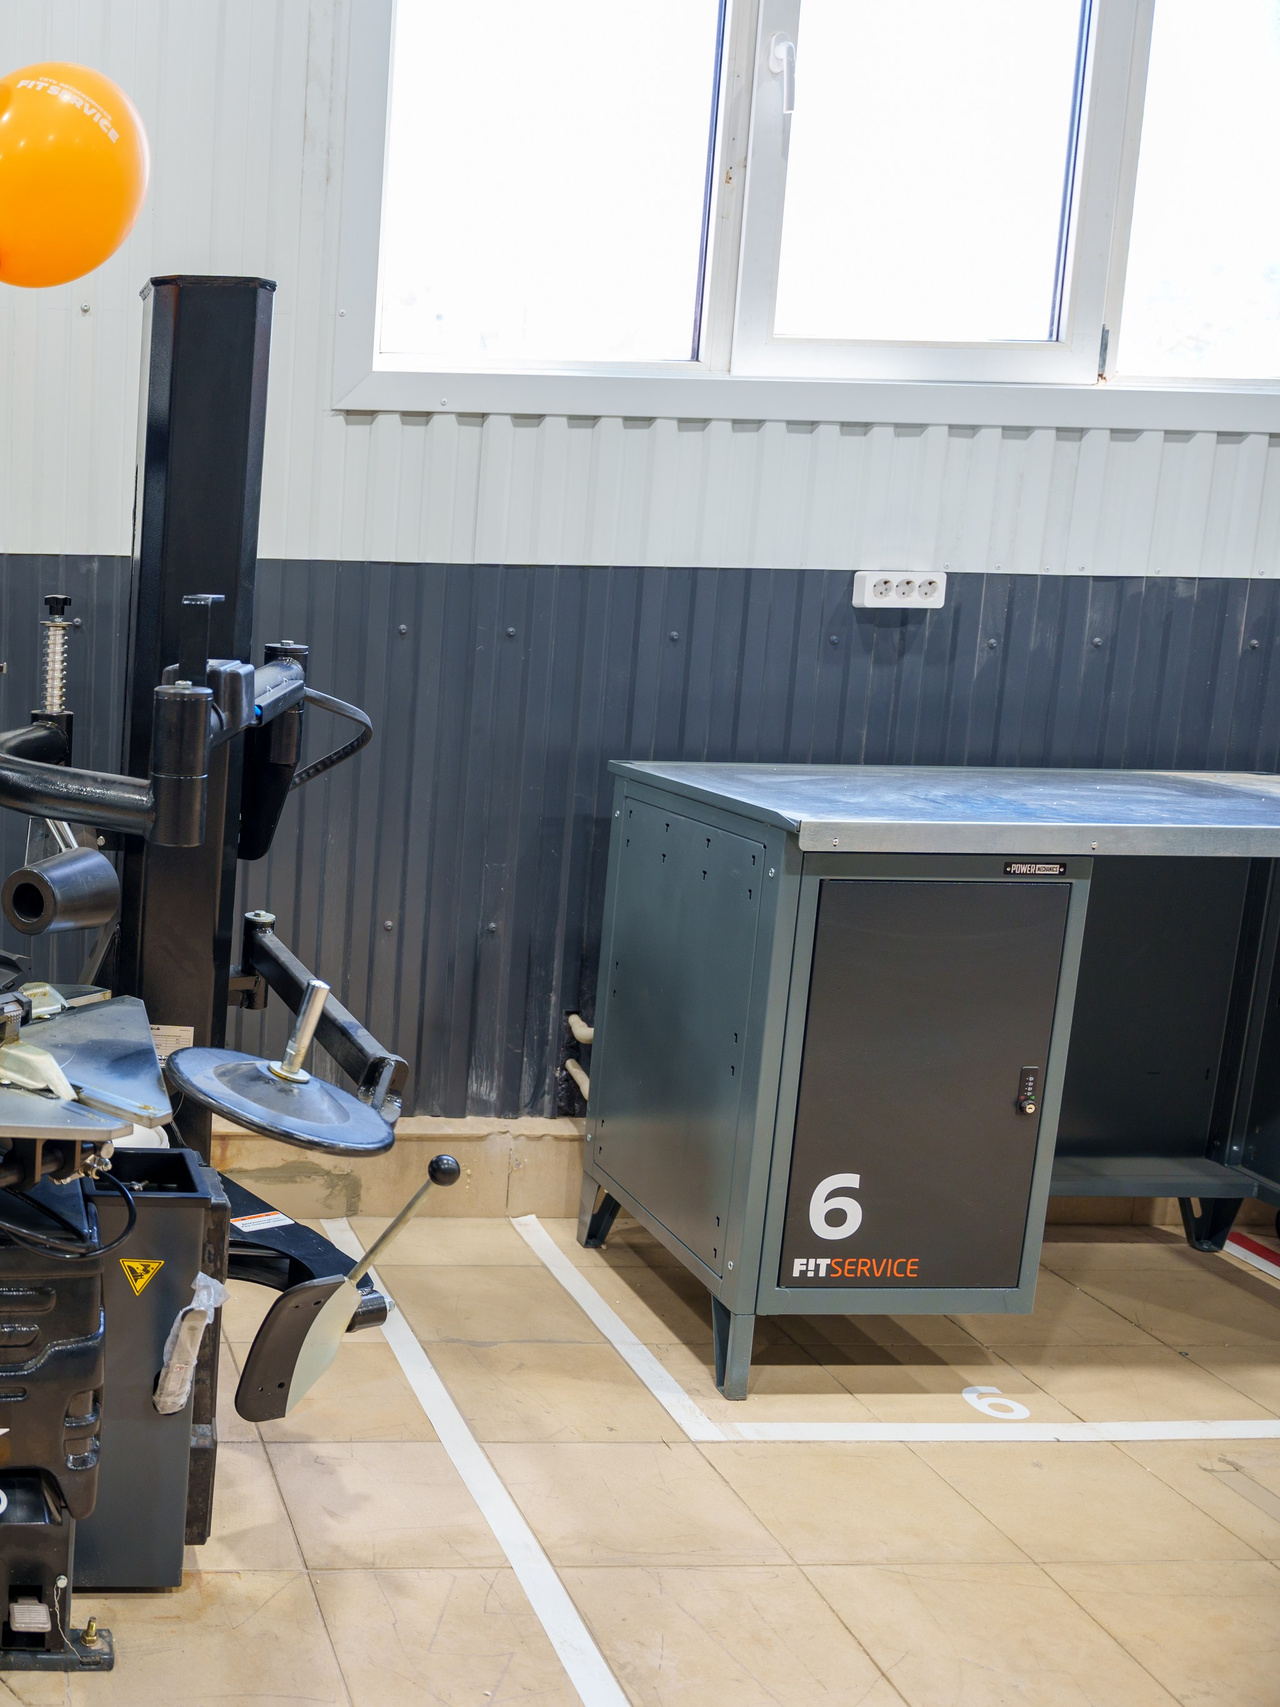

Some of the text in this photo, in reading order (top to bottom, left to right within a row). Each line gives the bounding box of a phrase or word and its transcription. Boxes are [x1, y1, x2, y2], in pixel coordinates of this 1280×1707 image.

[1011, 864, 1036, 874] POWER
[809, 1173, 863, 1240] 6
[962, 1385, 1031, 1420] 6
